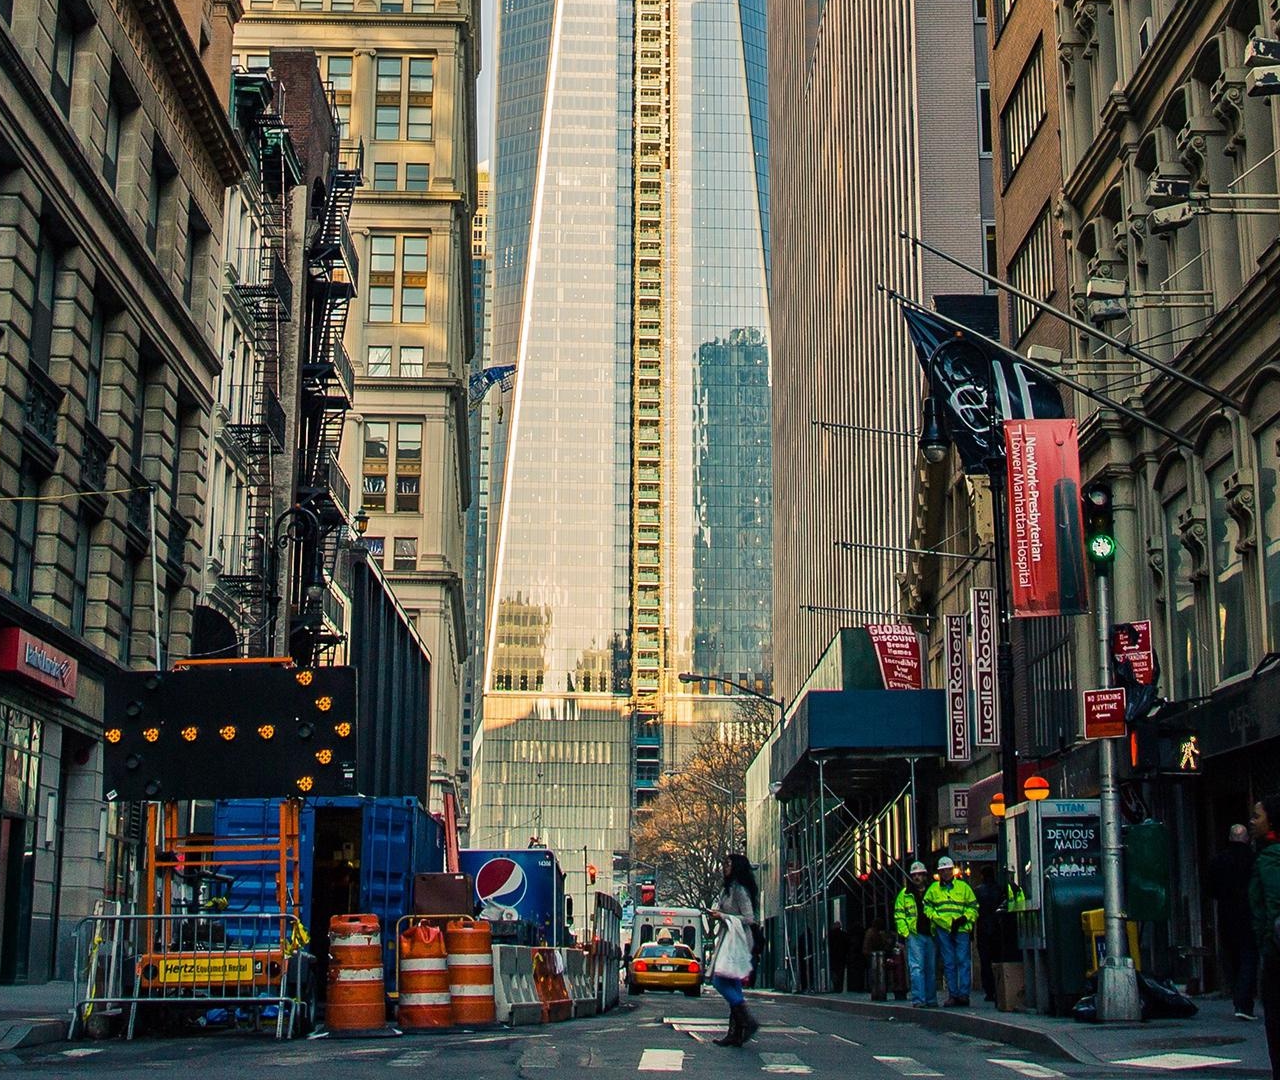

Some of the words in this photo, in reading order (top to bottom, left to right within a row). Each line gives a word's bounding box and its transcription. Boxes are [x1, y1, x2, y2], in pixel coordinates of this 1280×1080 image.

[1011, 437, 1022, 471] Lower
[1013, 473, 1026, 537] Manhattan
[1025, 436, 1043, 562] NewYork-Presbyterian
[1015, 540, 1031, 587] Hospital
[868, 624, 916, 636] GLOBAL
[872, 635, 917, 644] DISCOUNT
[976, 590, 991, 672] Roberts
[949, 616, 964, 694] Roberts
[1091, 702, 1118, 711] ANYTIME
[1096, 692, 1122, 702] STANDING
[980, 675, 993, 743] Lucille
[952, 694, 965, 759] Lucille
[1055, 803, 1085, 812] TITAN
[1046, 828, 1095, 840] DEVIOUS
[1054, 839, 1089, 850] MAIDS
[165, 963, 195, 975] Hertz
